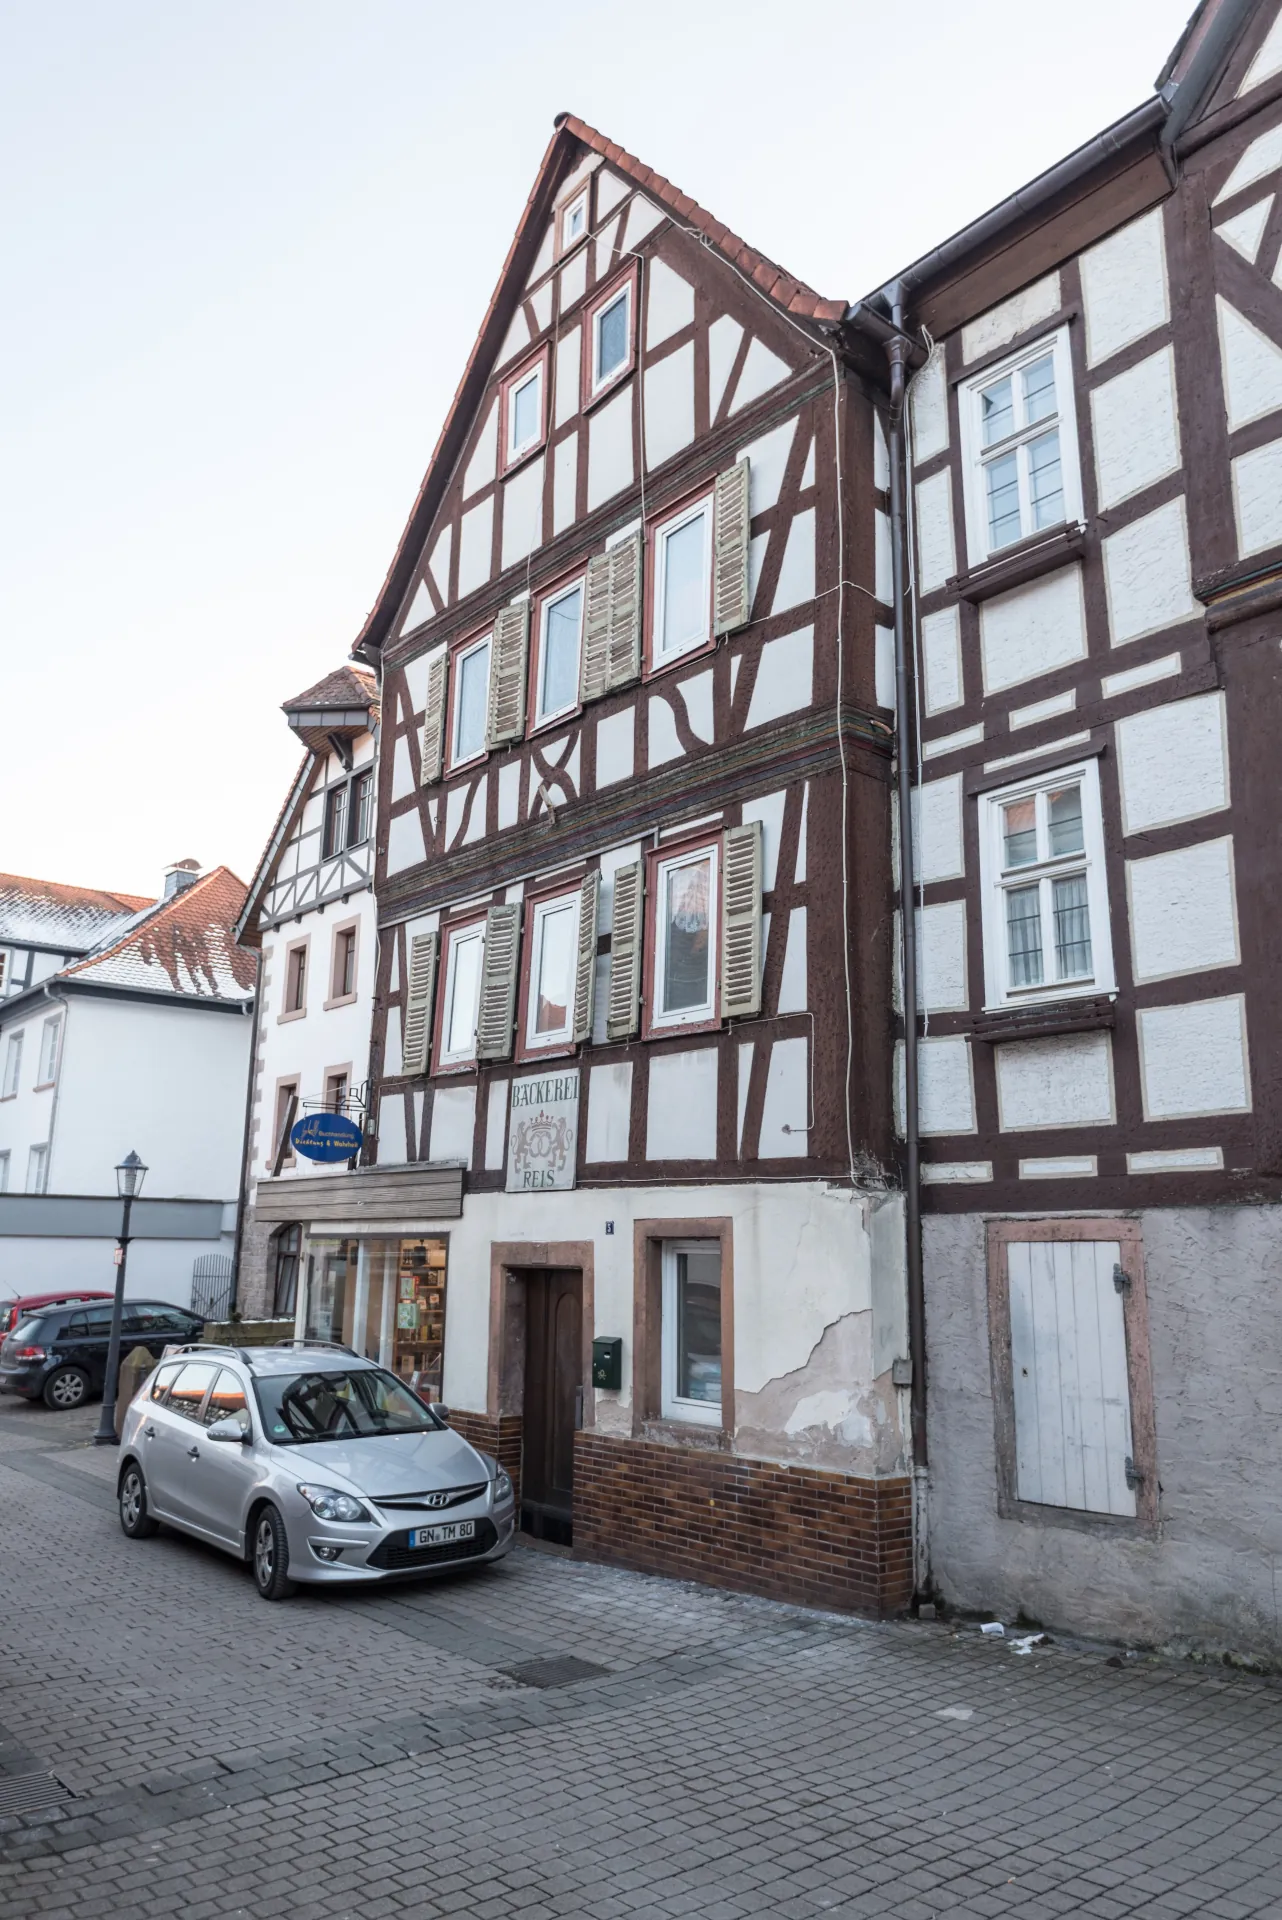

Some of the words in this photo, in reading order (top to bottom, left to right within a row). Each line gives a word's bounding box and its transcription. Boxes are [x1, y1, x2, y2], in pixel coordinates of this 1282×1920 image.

[512, 1076, 578, 1107] BÄCKEREI
[318, 1130, 355, 1140] Buchhandlung
[333, 1140, 359, 1148] Wahrheit
[522, 1169, 555, 1188] REIS
[420, 1529, 434, 1543] GN
[442, 1525, 456, 1539] TM
[459, 1523, 473, 1536] 80
